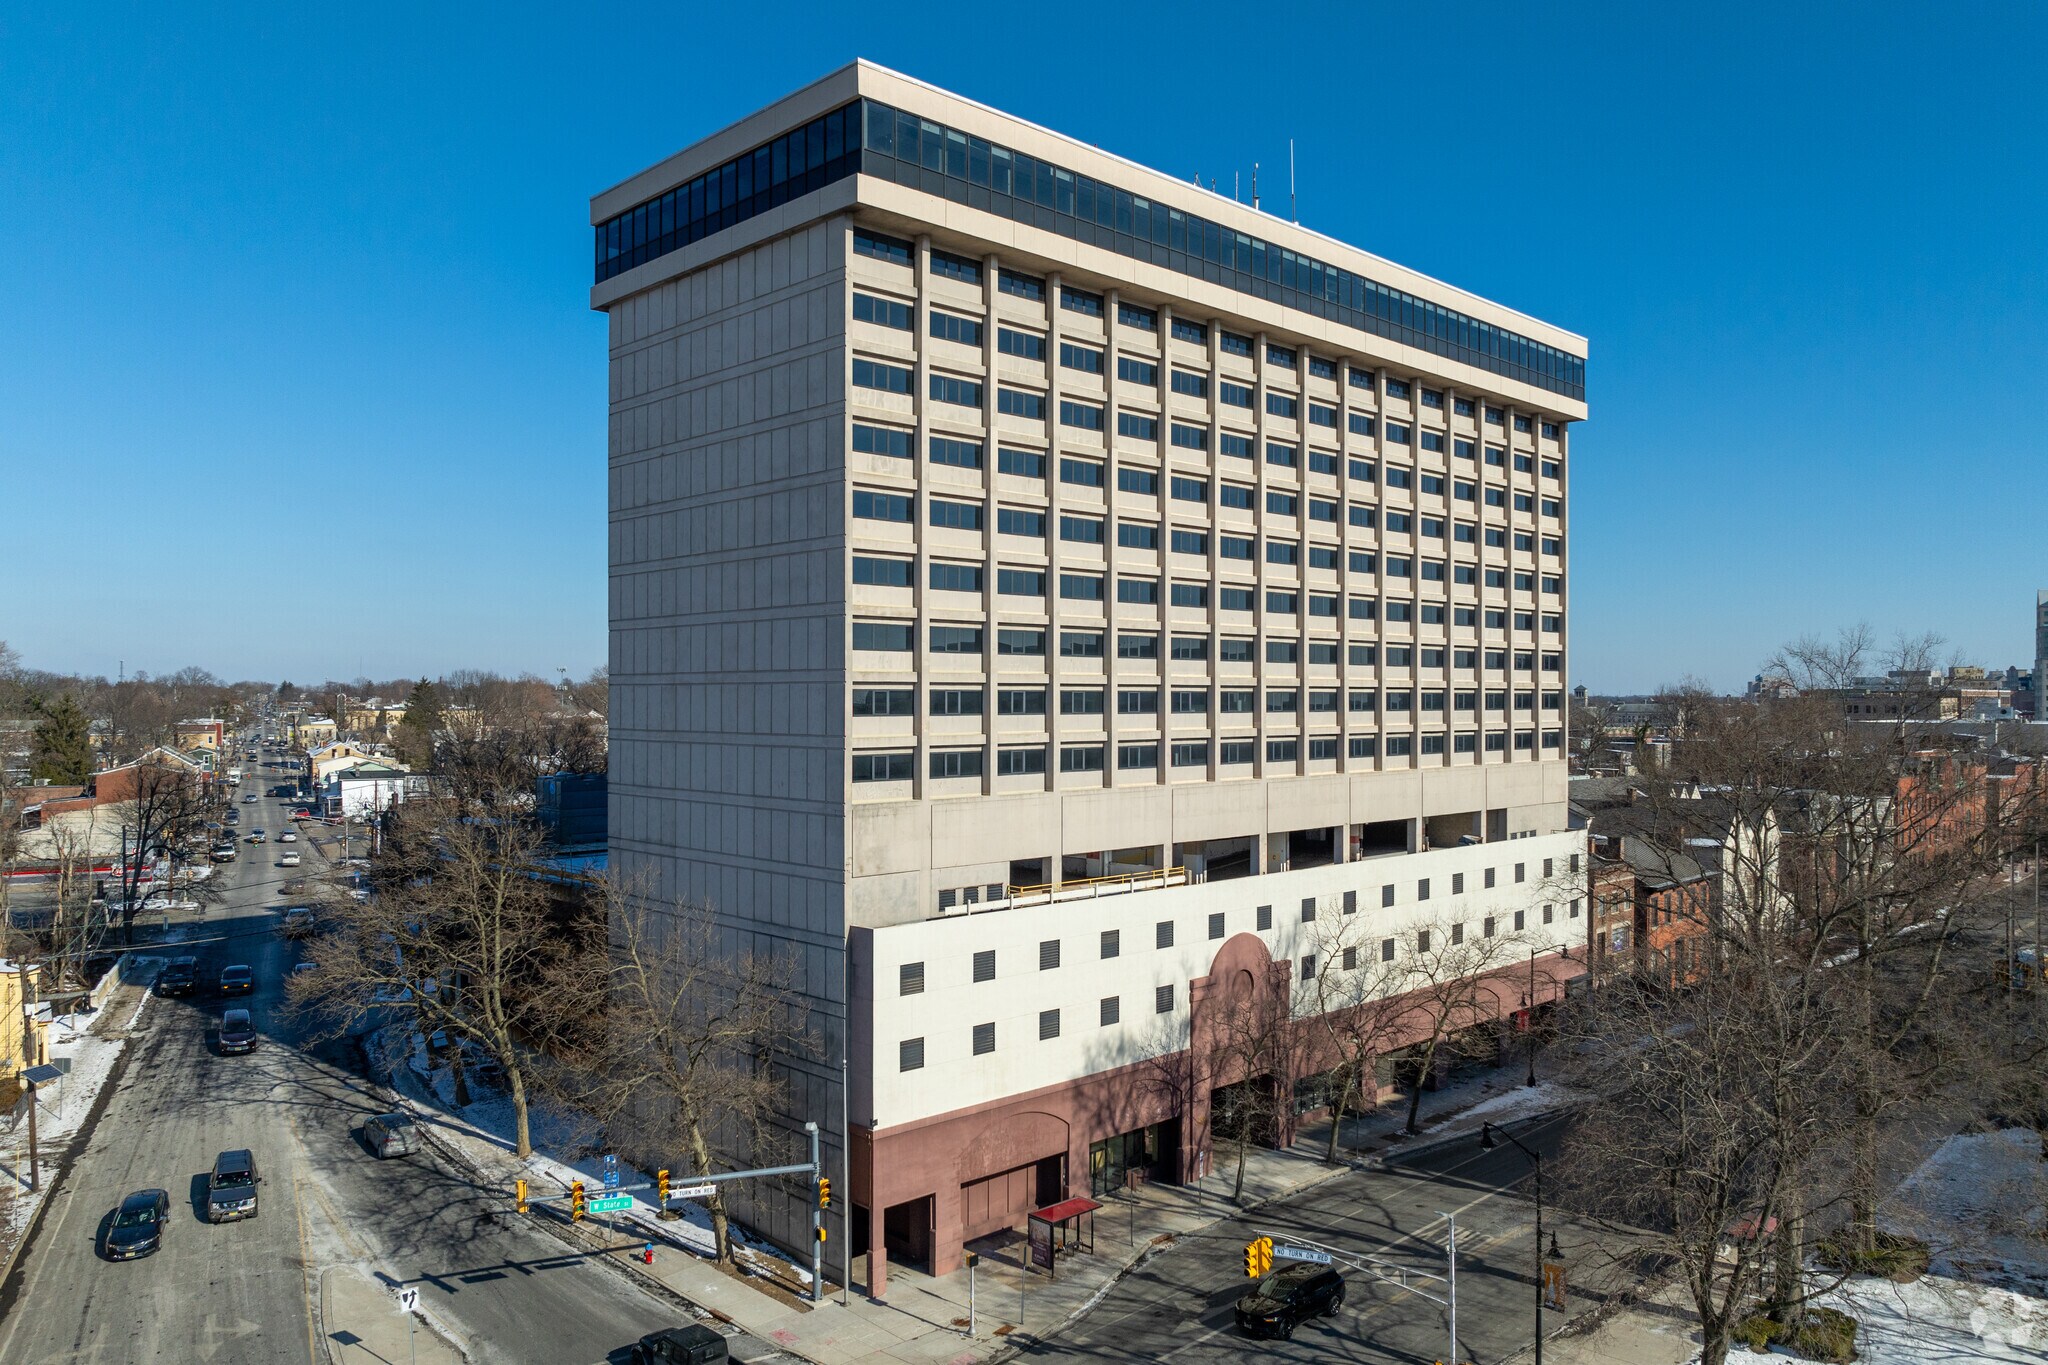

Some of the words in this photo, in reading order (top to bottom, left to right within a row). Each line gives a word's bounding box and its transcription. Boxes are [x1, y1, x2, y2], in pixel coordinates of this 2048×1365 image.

[603, 1201, 621, 1209] State
[1276, 1248, 1285, 1256] NO
[1288, 1250, 1303, 1258] TURN
[1305, 1252, 1314, 1260] ON
[1316, 1254, 1329, 1262] RED
